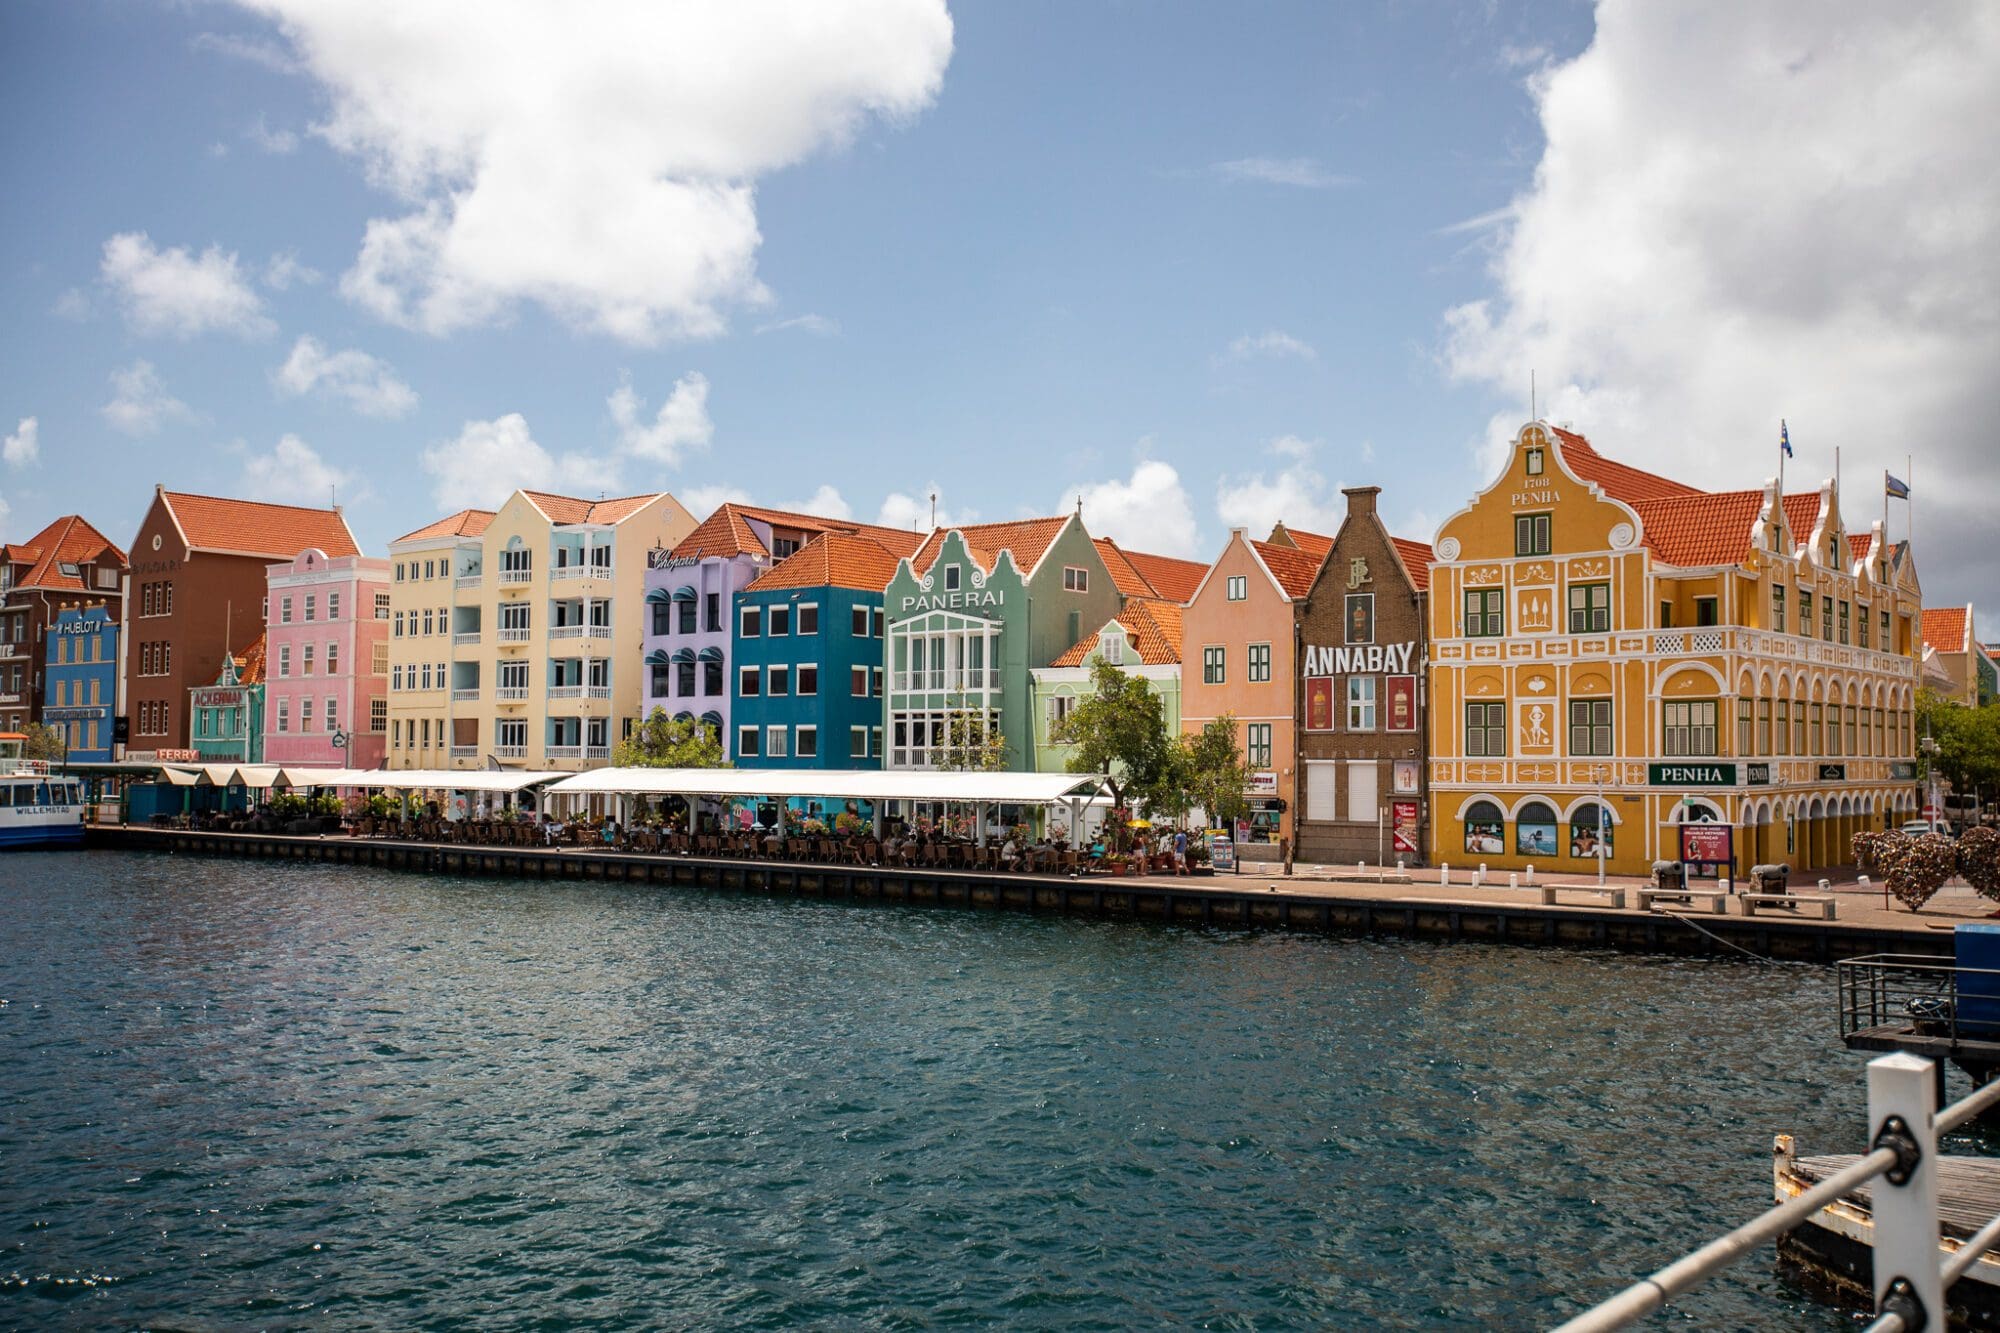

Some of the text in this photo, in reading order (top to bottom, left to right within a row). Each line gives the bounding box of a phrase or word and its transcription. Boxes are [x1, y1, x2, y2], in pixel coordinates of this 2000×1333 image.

[1524, 478, 1550, 488] 1708
[1511, 491, 1561, 506] PENHA
[651, 548, 703, 572] Chopard
[902, 590, 1004, 611] PANERAI
[63, 620, 95, 634] HUBLOT
[1303, 641, 1416, 677] ANNABAY
[159, 749, 197, 760] FERRY
[1661, 767, 1723, 782] PENHA
[1749, 767, 1768, 782] PENHA
[16, 806, 70, 815] WILLEMSTAD
